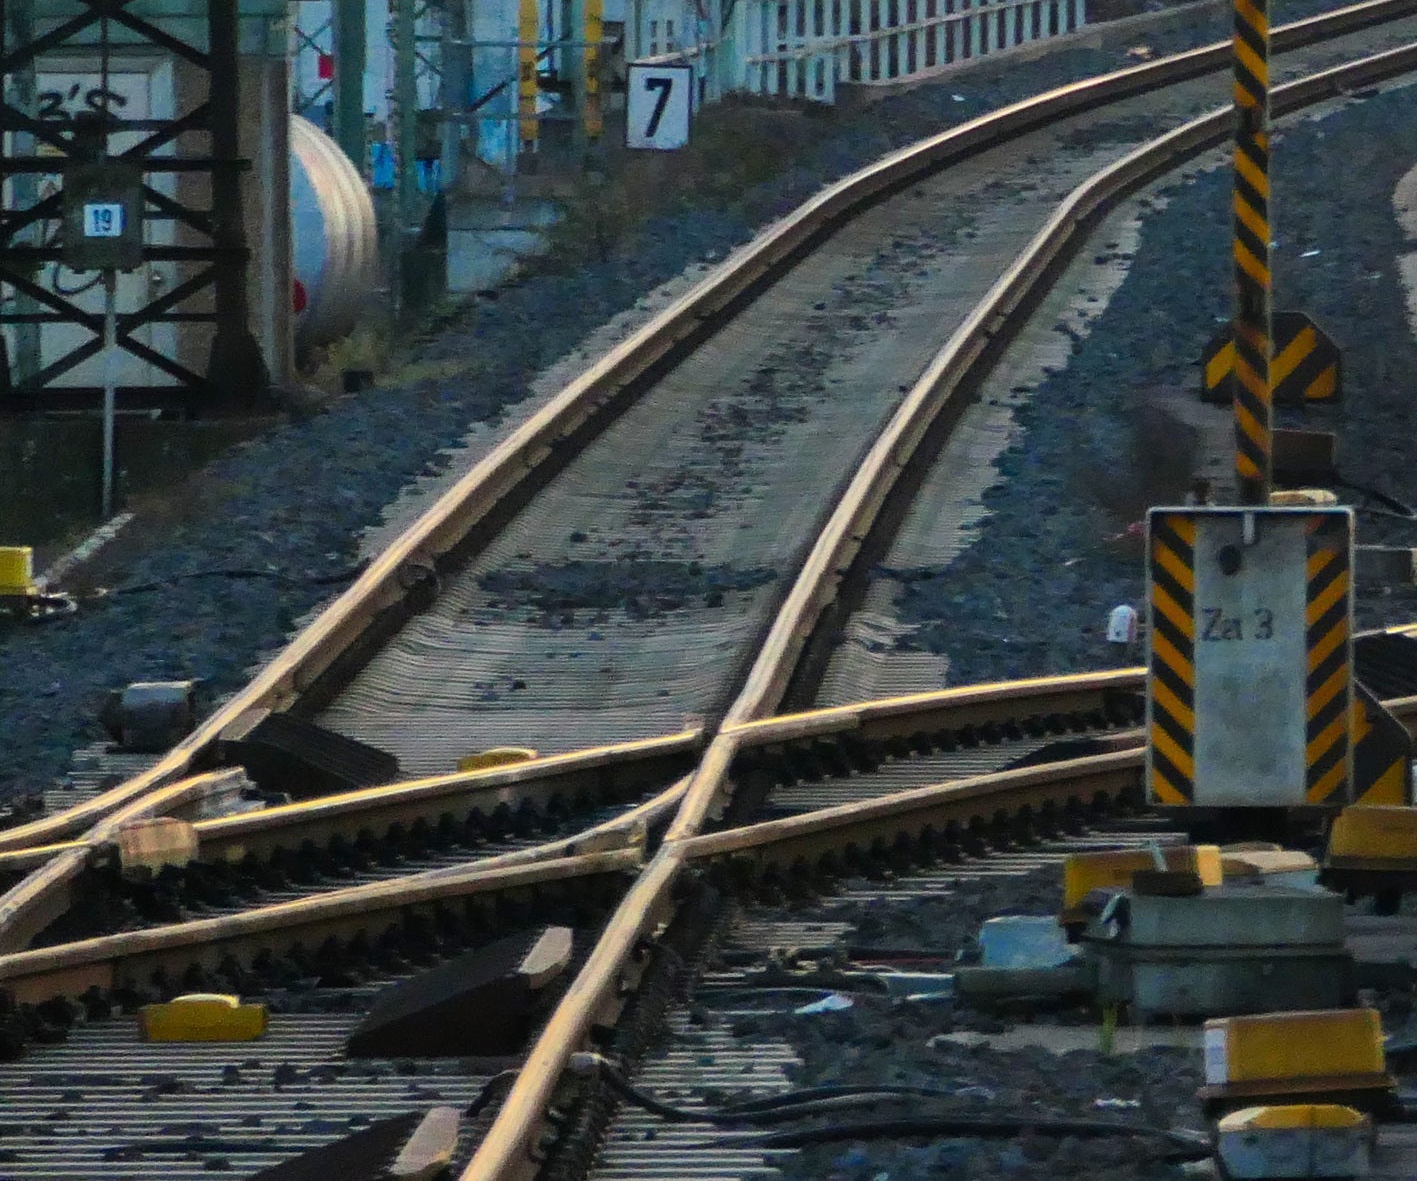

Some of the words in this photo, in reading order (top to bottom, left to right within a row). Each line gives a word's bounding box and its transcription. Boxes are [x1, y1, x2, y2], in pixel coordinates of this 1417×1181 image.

[645, 77, 673, 138] 7
[1202, 607, 1243, 642] Za
[1254, 607, 1275, 640] 3
